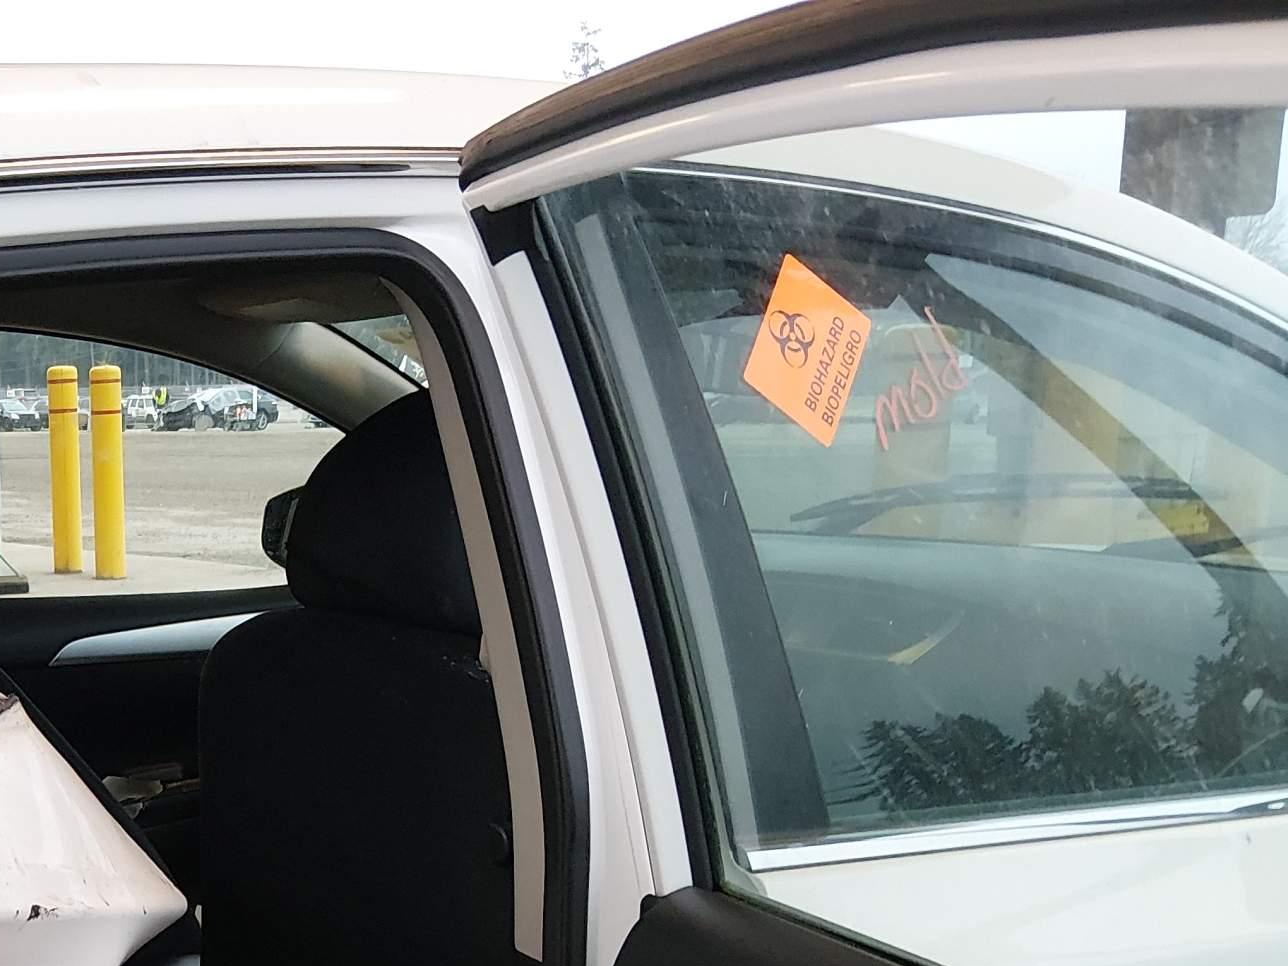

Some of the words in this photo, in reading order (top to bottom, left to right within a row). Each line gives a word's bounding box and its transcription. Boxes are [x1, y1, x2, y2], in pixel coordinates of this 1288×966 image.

[804, 316, 845, 412] BIOHAZARD
[821, 329, 862, 427] BIOPELIGRO
[876, 306, 968, 450] mold
